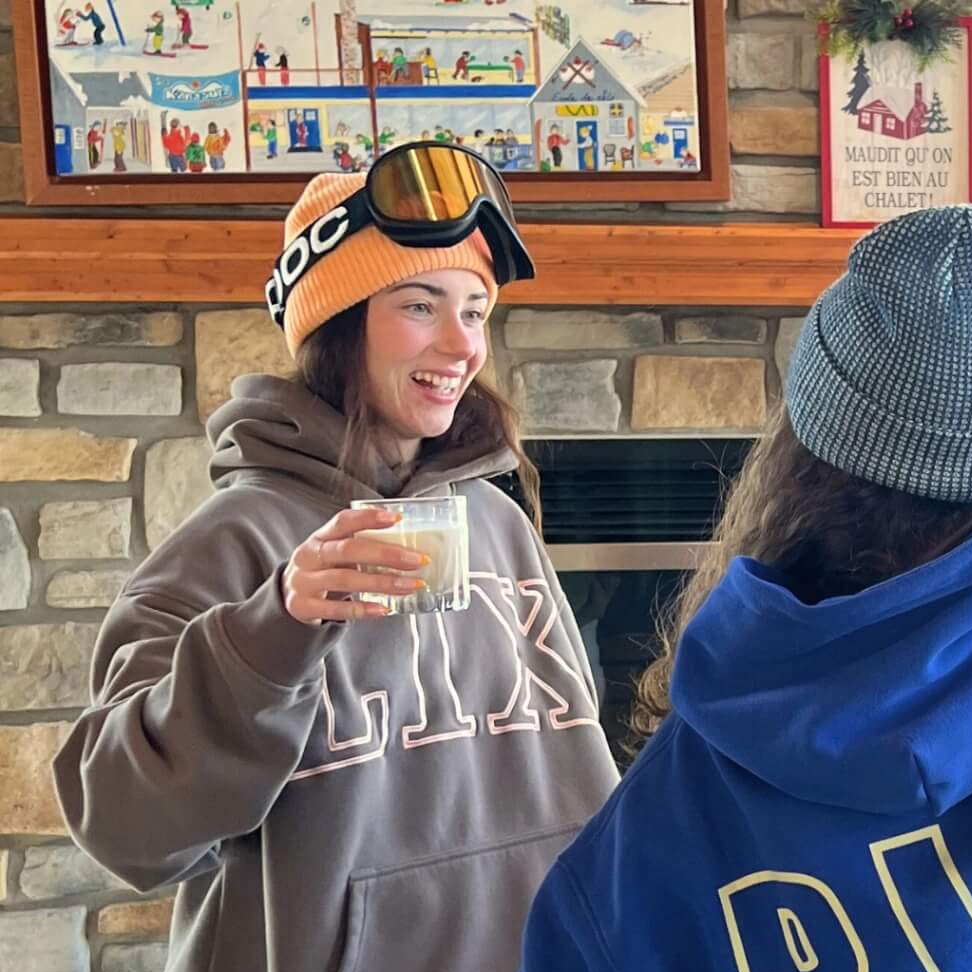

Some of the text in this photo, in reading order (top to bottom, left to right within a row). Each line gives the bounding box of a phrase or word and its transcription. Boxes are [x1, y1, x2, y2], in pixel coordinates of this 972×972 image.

[845, 146, 901, 163] MAUDIT
[852, 170, 949, 188] EST BIEN AU
